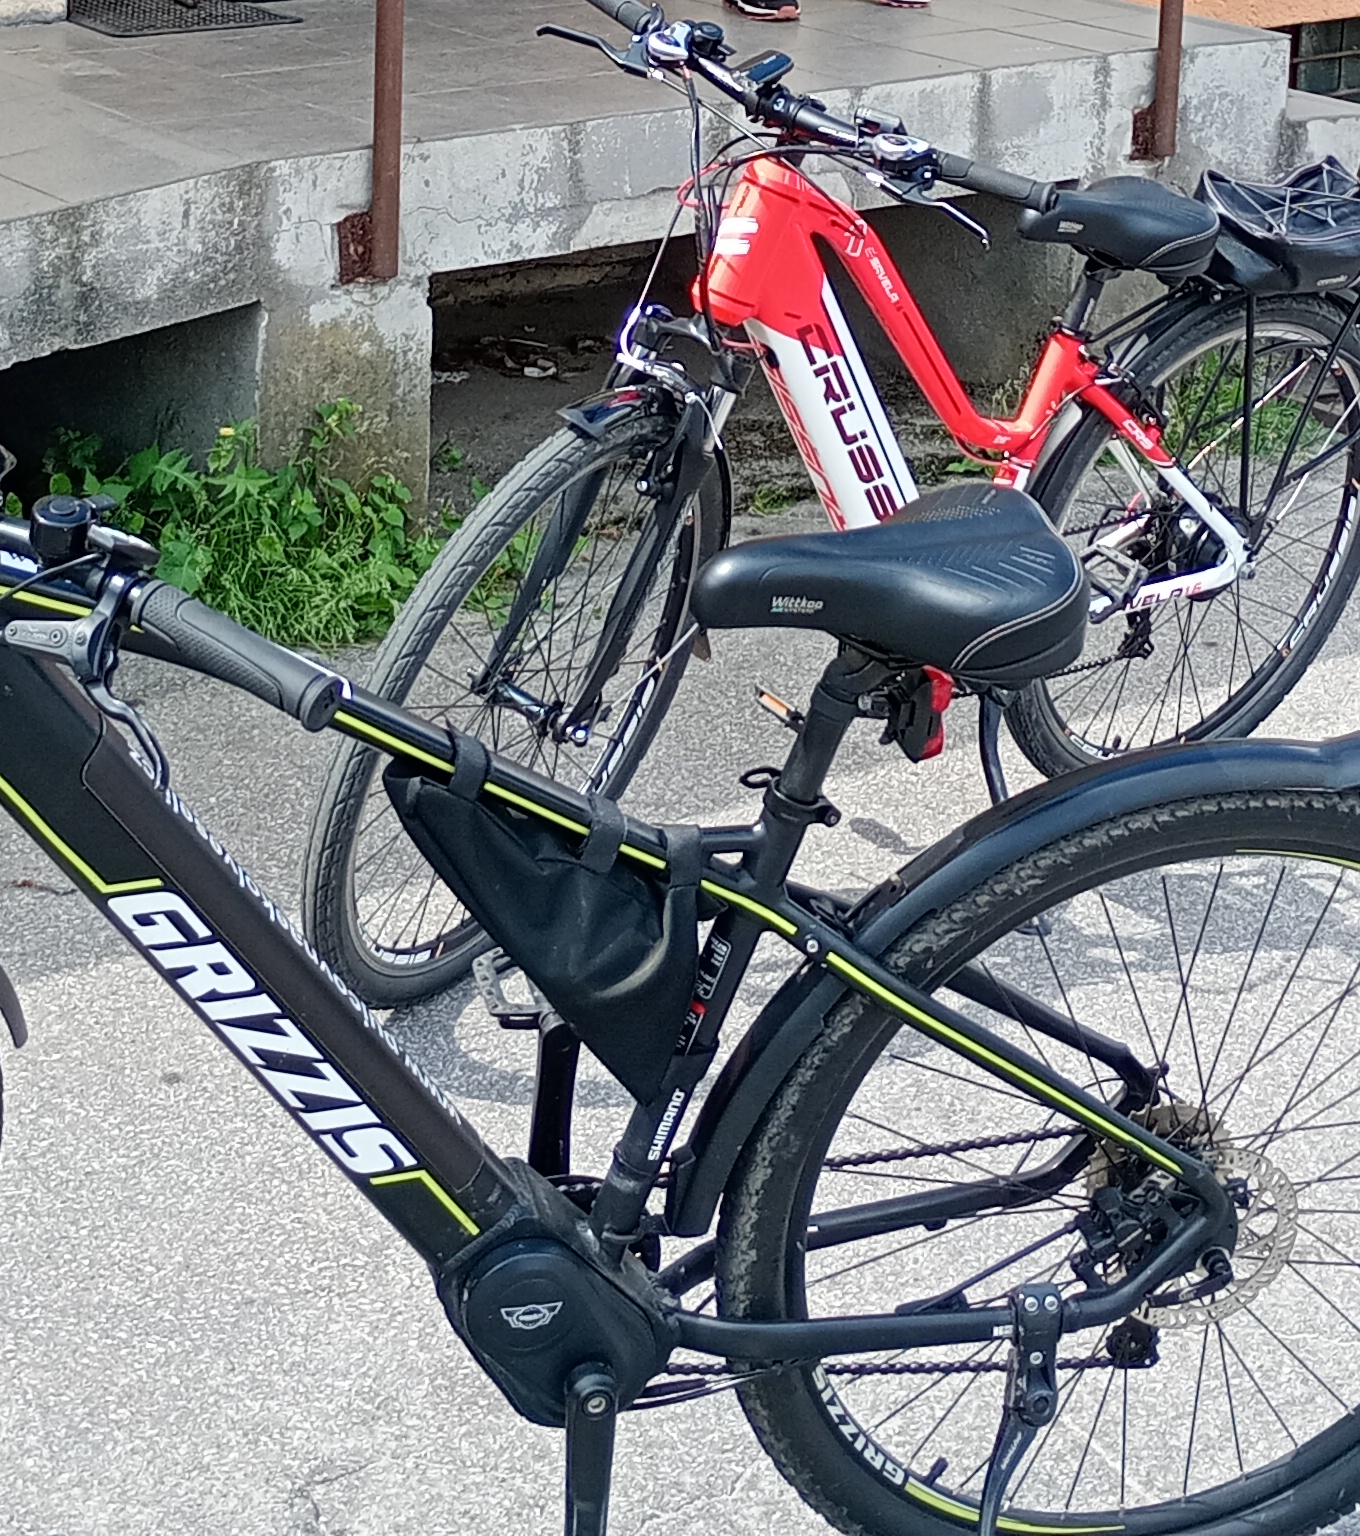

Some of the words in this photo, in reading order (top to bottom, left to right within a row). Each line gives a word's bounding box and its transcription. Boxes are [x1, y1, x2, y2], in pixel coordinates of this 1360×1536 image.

[1122, 419, 1155, 450] CRS
[107, 891, 419, 1175] GRIZZIS
[647, 1086, 688, 1162] SHIMANO
[811, 1364, 907, 1487] GRIZZIS
